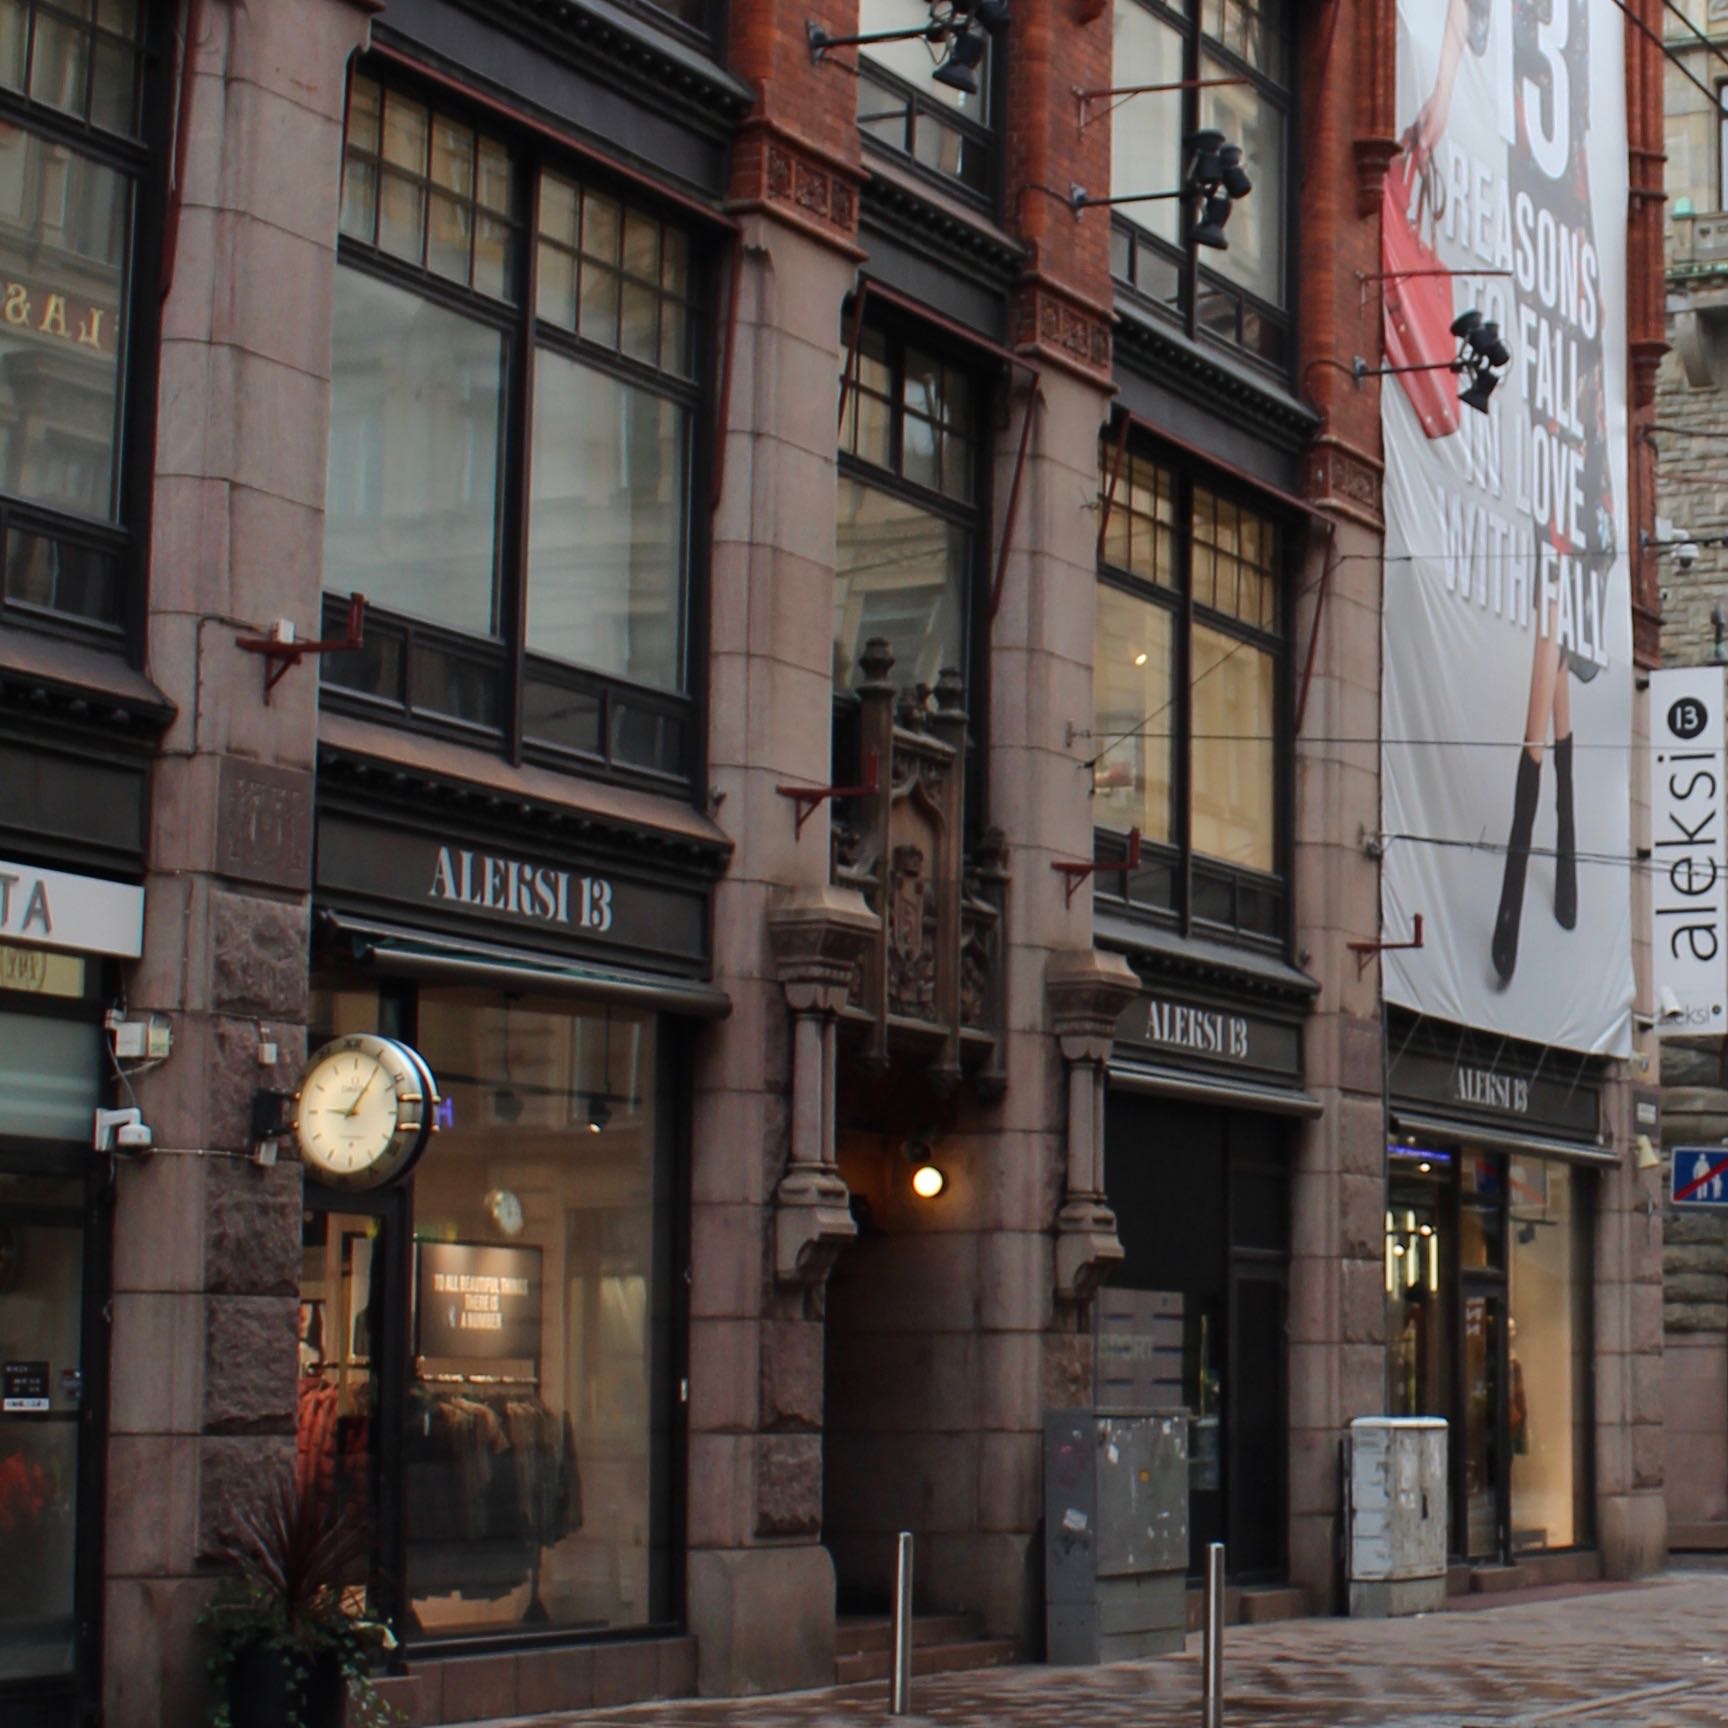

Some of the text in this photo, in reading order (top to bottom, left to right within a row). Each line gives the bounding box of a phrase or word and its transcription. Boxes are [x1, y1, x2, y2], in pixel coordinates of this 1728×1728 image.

[1446, 139, 1598, 341] REASONS
[1519, 302, 1585, 440] FALL
[1514, 410, 1588, 551] LOVE
[1436, 484, 1609, 669] WITH FALL
[1675, 705, 1699, 731] 13
[428, 846, 613, 933] ALEKSI 13
[1654, 753, 1719, 963] aleksi
[1145, 1000, 1249, 1059] ALEKSI 13
[1453, 1066, 1529, 1113] ALEKSI 13
